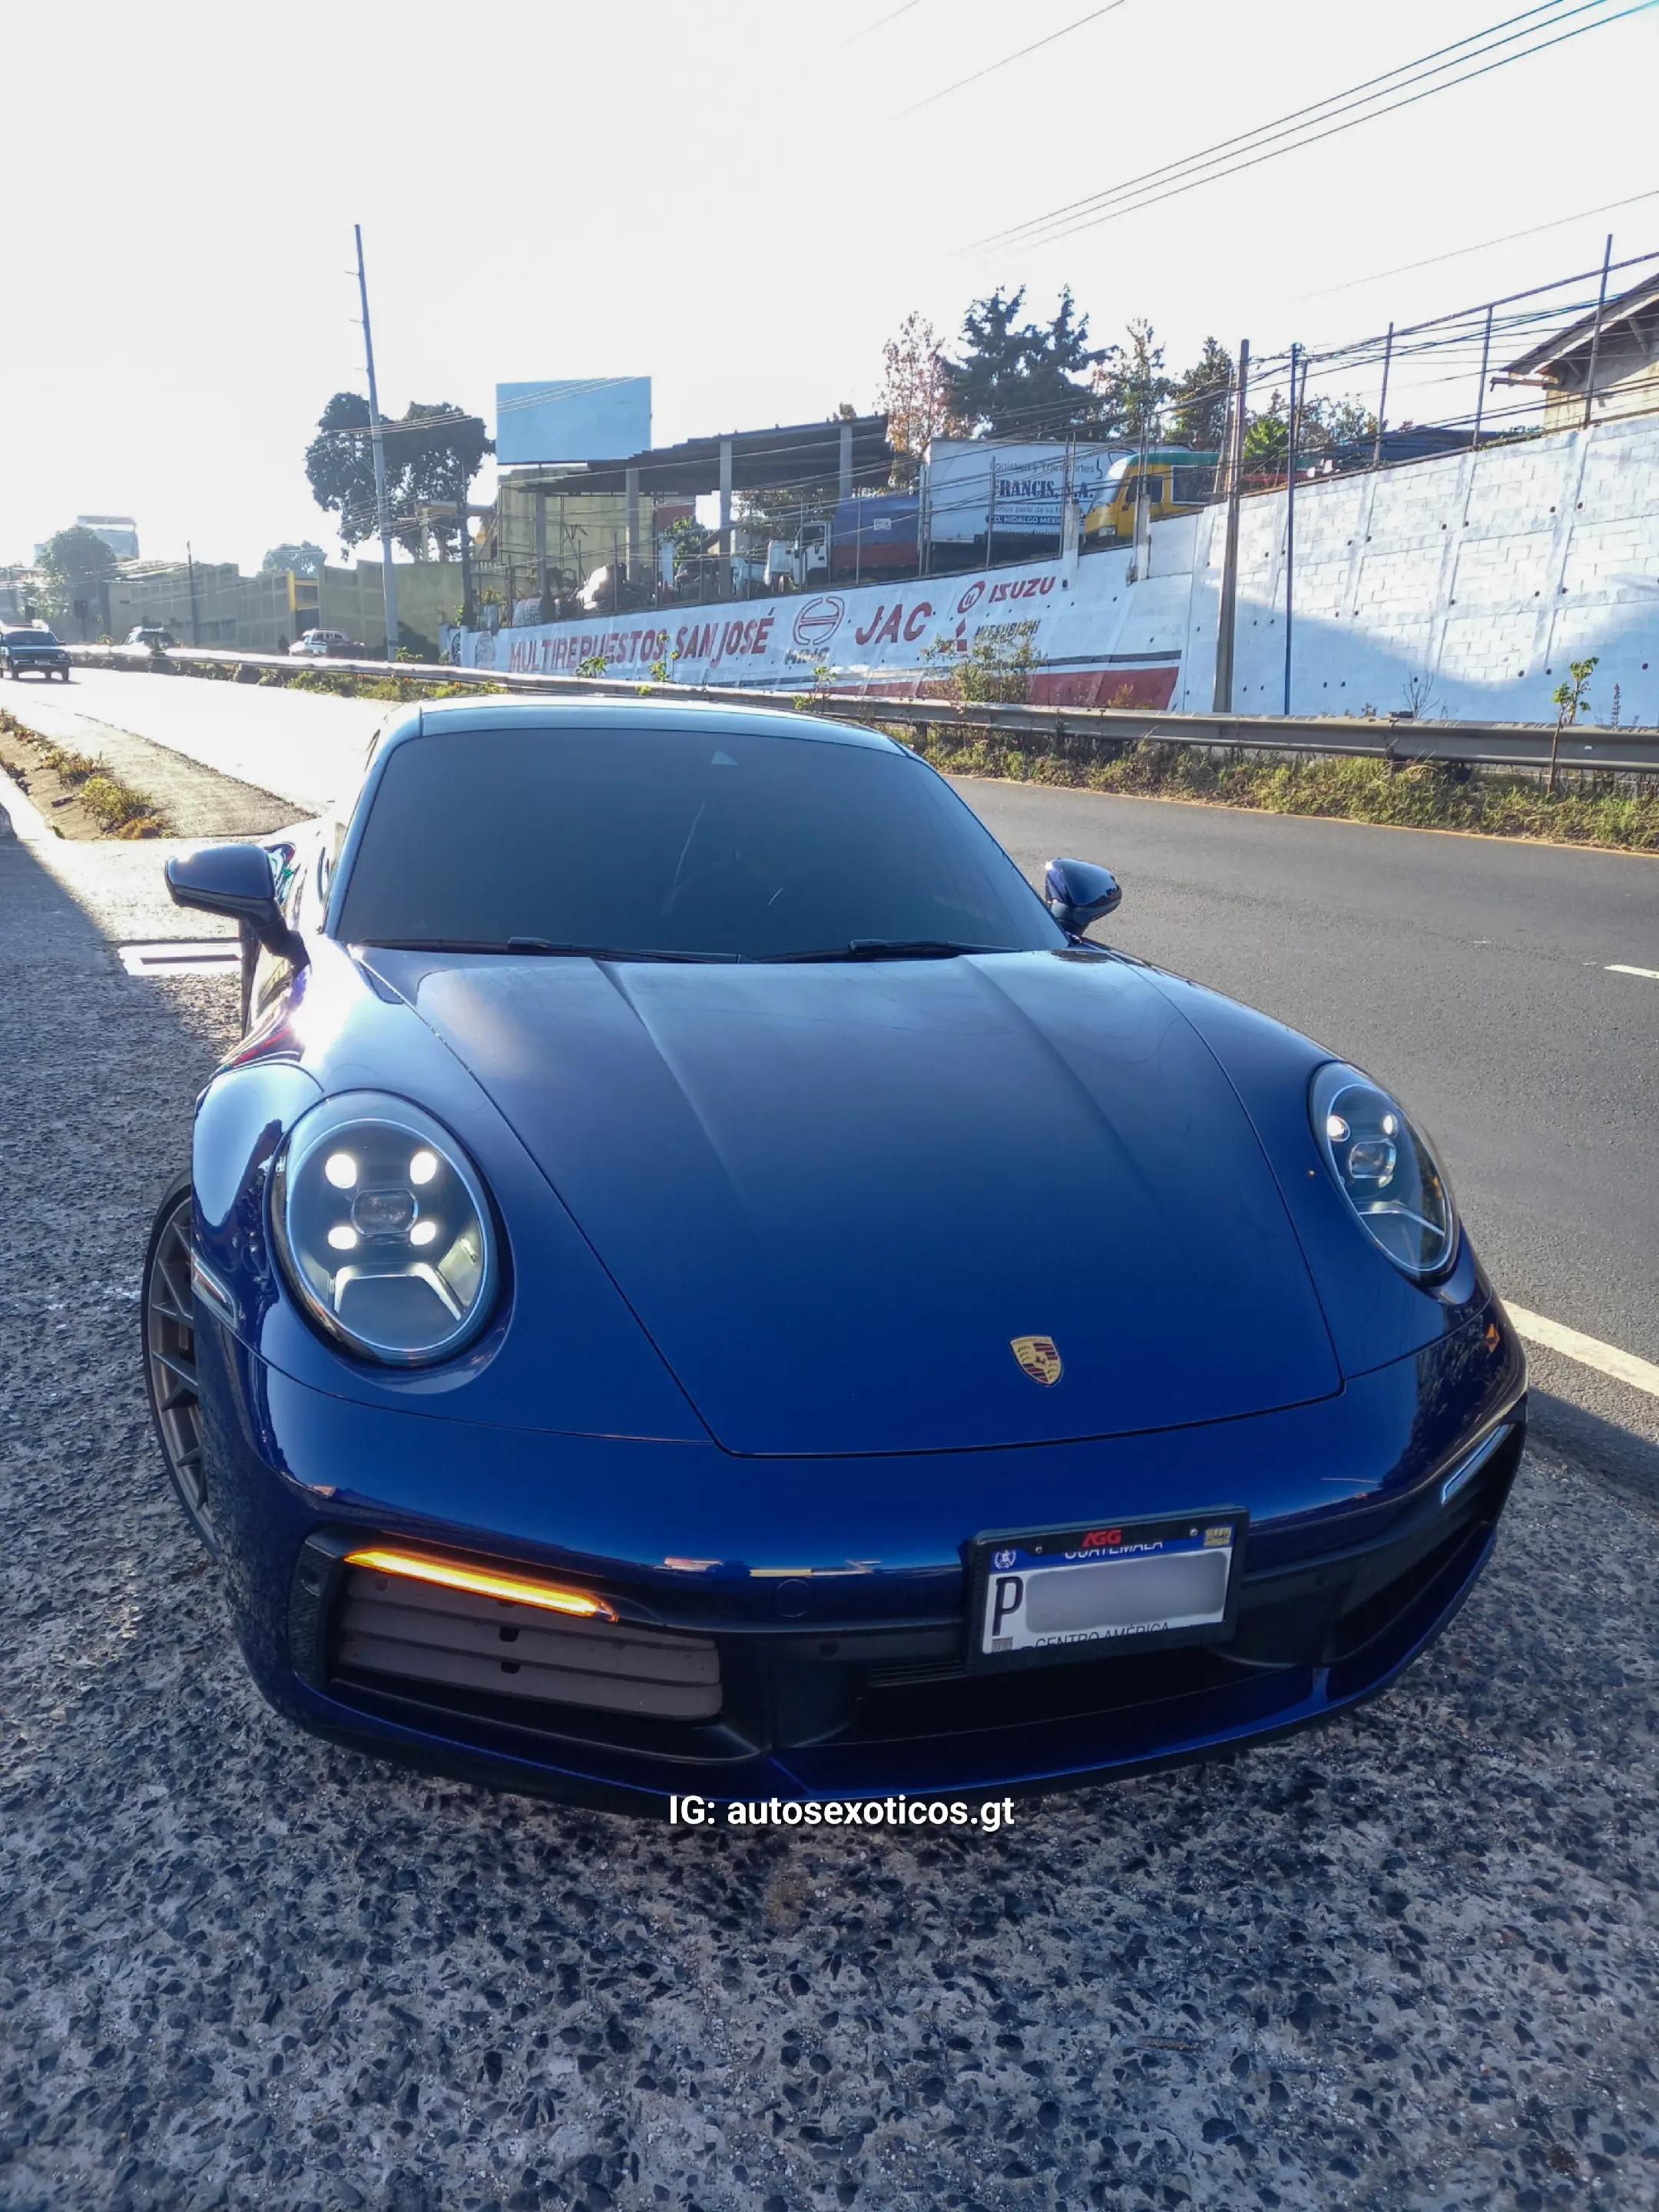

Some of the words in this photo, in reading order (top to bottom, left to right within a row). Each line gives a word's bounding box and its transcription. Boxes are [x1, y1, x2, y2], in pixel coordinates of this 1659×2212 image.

[1004, 515, 1038, 524] HIDALGO
[988, 576, 1057, 604] ISUZU
[510, 628, 667, 673] MULTIREPUESTOS
[676, 623, 718, 661] SAN
[710, 607, 775, 669] JOSÉ
[856, 601, 932, 645] JAC
[992, 1576, 1024, 1636] P
